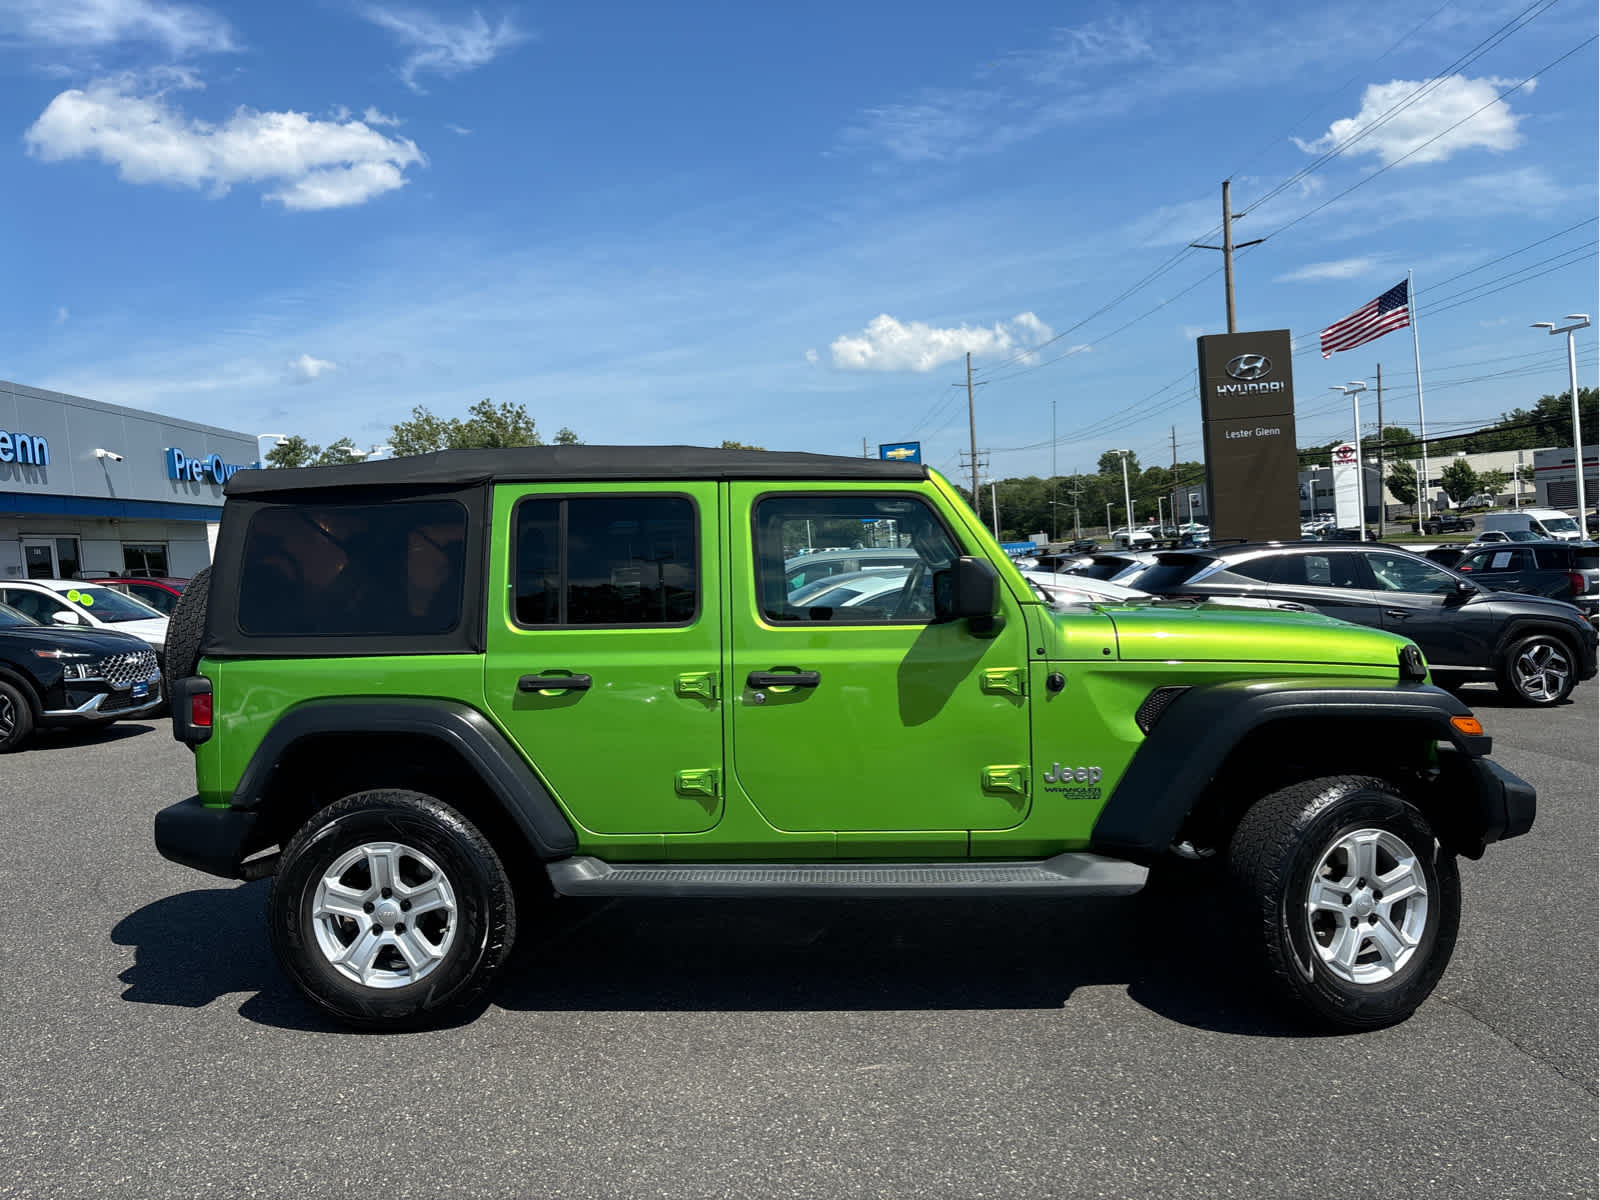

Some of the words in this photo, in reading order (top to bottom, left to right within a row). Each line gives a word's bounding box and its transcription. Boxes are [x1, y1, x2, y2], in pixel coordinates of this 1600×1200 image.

[1216, 381, 1285, 396] HYUNDAI
[1225, 429, 1253, 439] Lester
[1255, 426, 1281, 437] Glenn
[1043, 762, 1103, 785] Jeep
